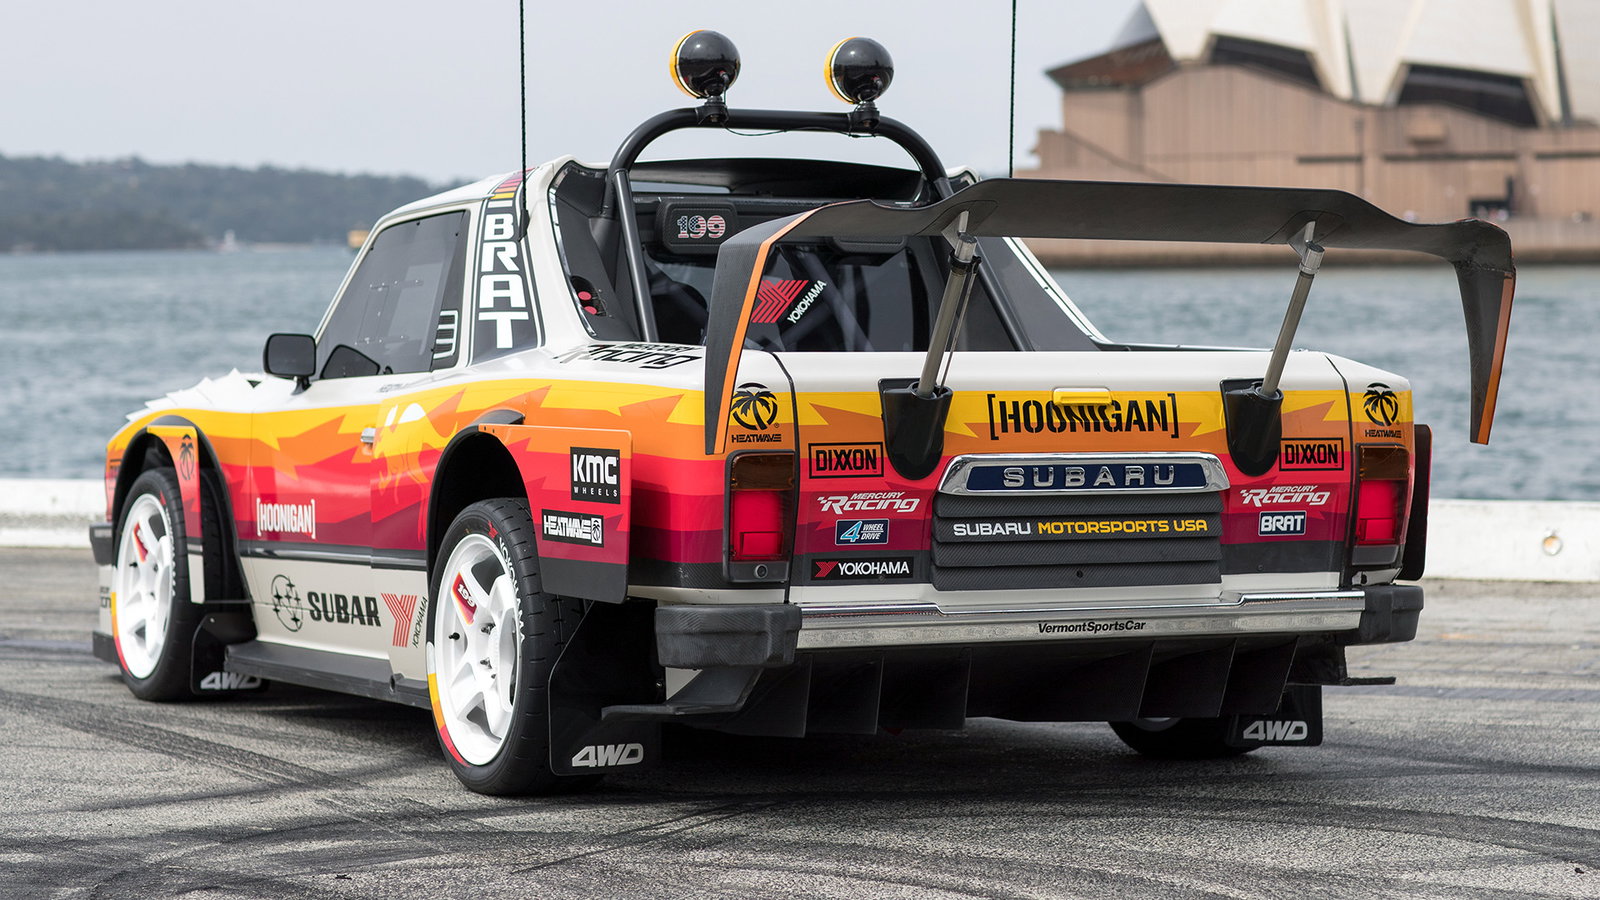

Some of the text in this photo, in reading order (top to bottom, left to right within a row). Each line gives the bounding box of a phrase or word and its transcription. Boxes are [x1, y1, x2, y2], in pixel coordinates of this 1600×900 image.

[676, 215, 726, 239] 199
[478, 212, 529, 349] BRAT
[786, 279, 827, 325] YOKOHAMA
[731, 433, 782, 443] HEATWAVE
[1364, 429, 1402, 439] HEATWAVE
[815, 448, 878, 472] DIXXON
[1284, 443, 1339, 465] DIXXON
[572, 453, 618, 485] KMC
[1003, 464, 1175, 488] SUBARU
[573, 486, 618, 498] WHEELS
[850, 491, 905, 500] MERCURY
[1241, 489, 1331, 508] Racing
[1269, 485, 1318, 493] MERCURY
[818, 495, 921, 515] Racing
[543, 515, 592, 541] HEATWAVE
[840, 520, 884, 543] 4 WHEEL
[953, 519, 1208, 537] SUBARU MOTORSPORTS USA
[1260, 514, 1305, 532] BRAT
[860, 532, 881, 540] DRIVE
[838, 561, 910, 576] YOKOHAMA
[457, 583, 477, 608] 199
[412, 596, 429, 649] YOKOHAMA
[1038, 620, 1147, 635] VermontSportsCar
[200, 671, 262, 690] 4WD
[1243, 720, 1308, 741] 4WD
[572, 743, 645, 768] 4WD
